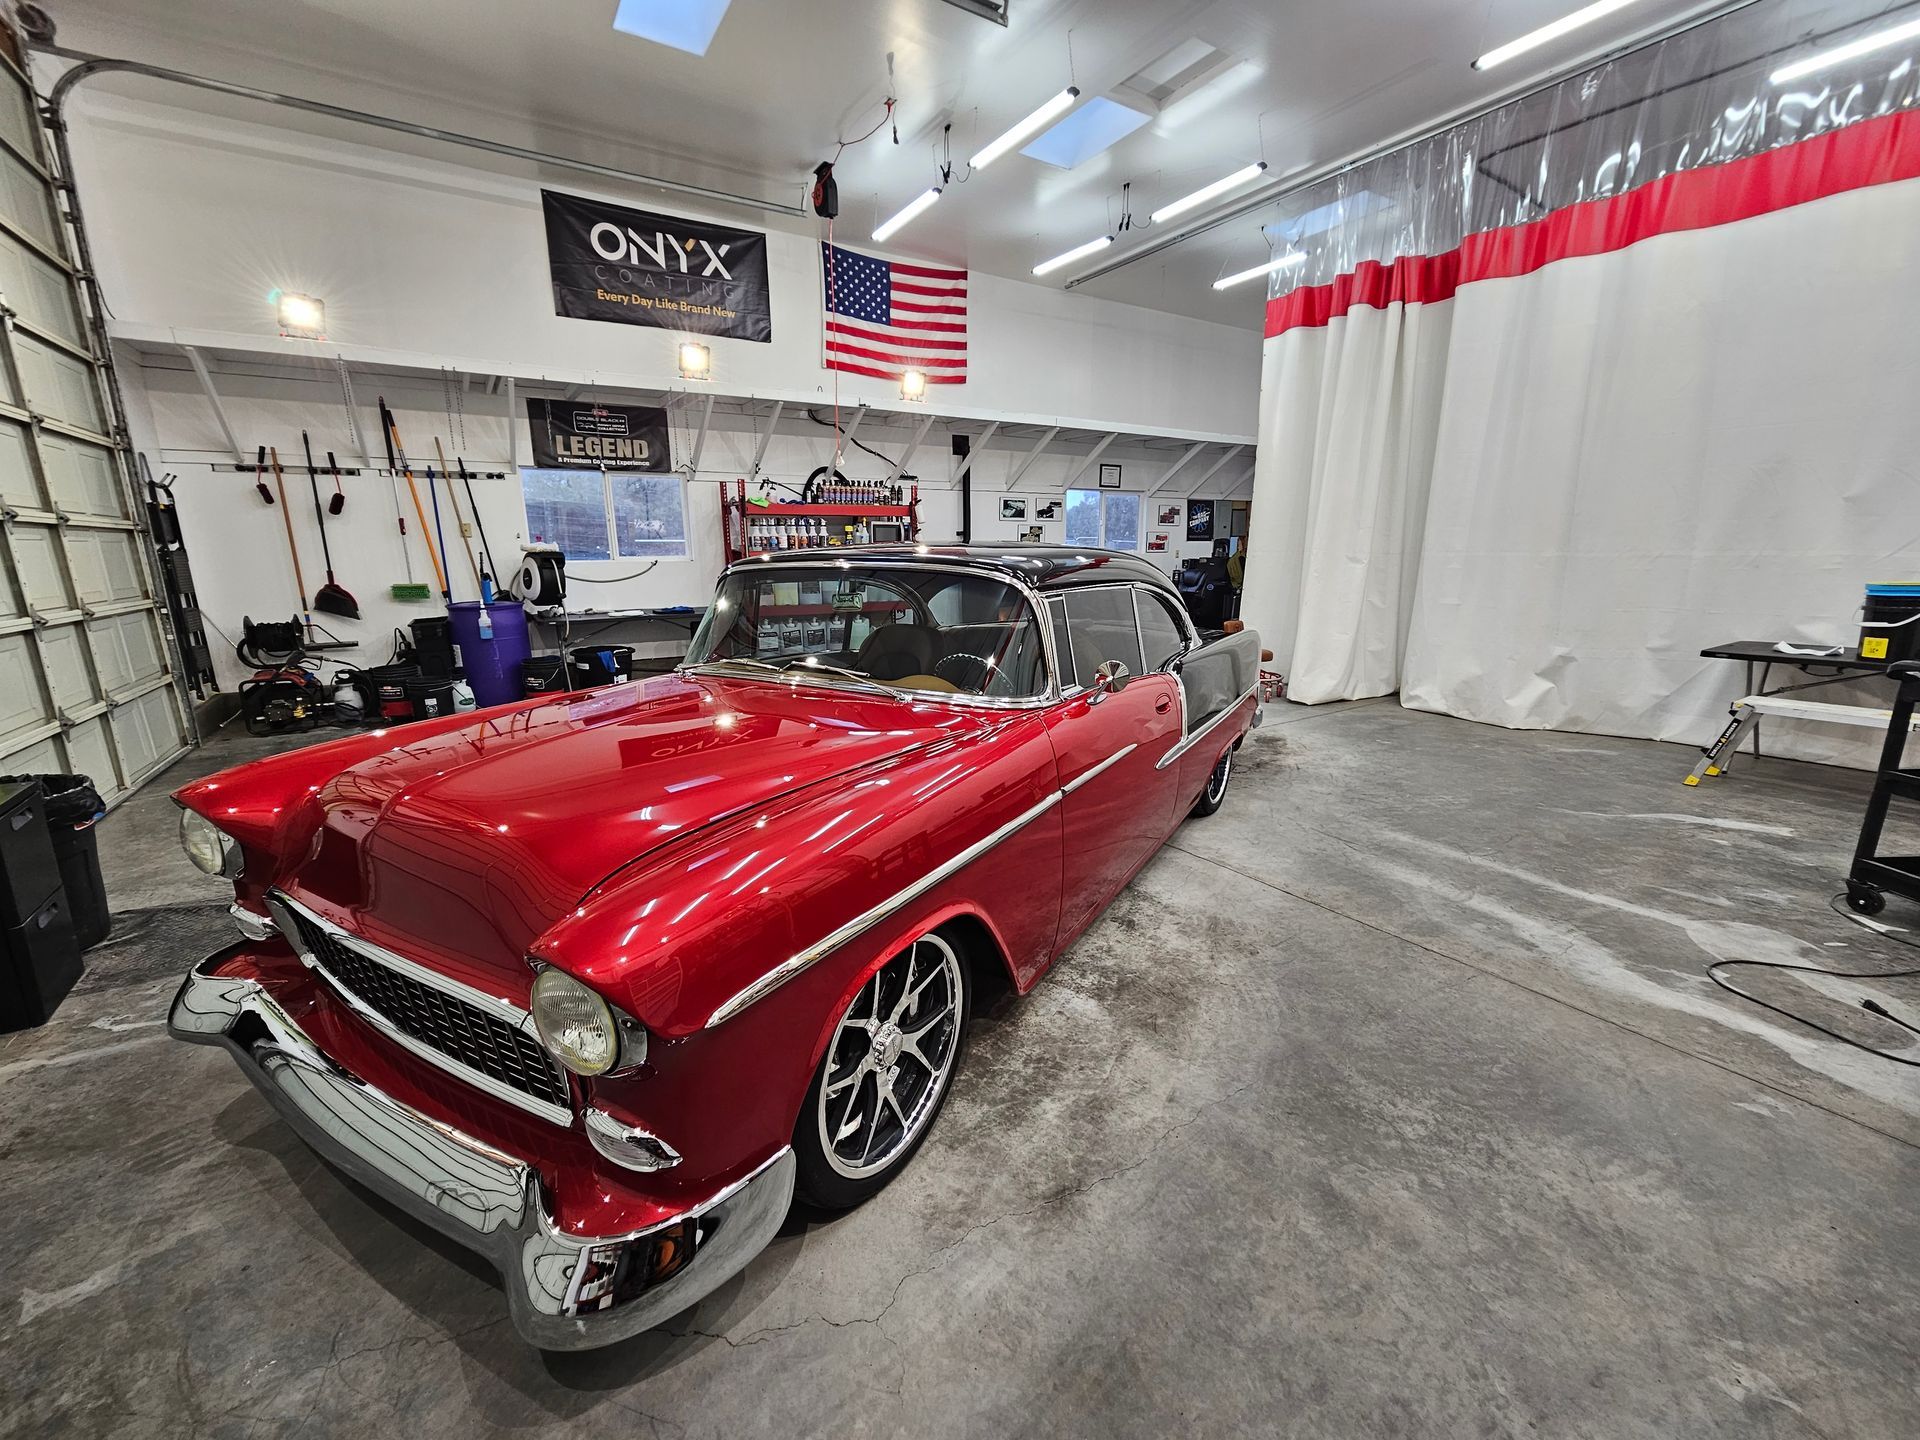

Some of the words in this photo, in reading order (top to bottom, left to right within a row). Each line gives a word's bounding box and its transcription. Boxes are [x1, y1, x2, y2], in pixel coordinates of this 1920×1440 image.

[590, 222, 732, 280] ONYX
[594, 265, 734, 299] COATING
[596, 289, 629, 305] Every
[631, 294, 652, 308] Day
[655, 298, 678, 311] Like
[680, 302, 711, 315] Brand
[712, 307, 736, 318] New
[555, 435, 649, 459] LEGEND
[592, 458, 616, 466] Coting
[617, 459, 650, 467] Experience
